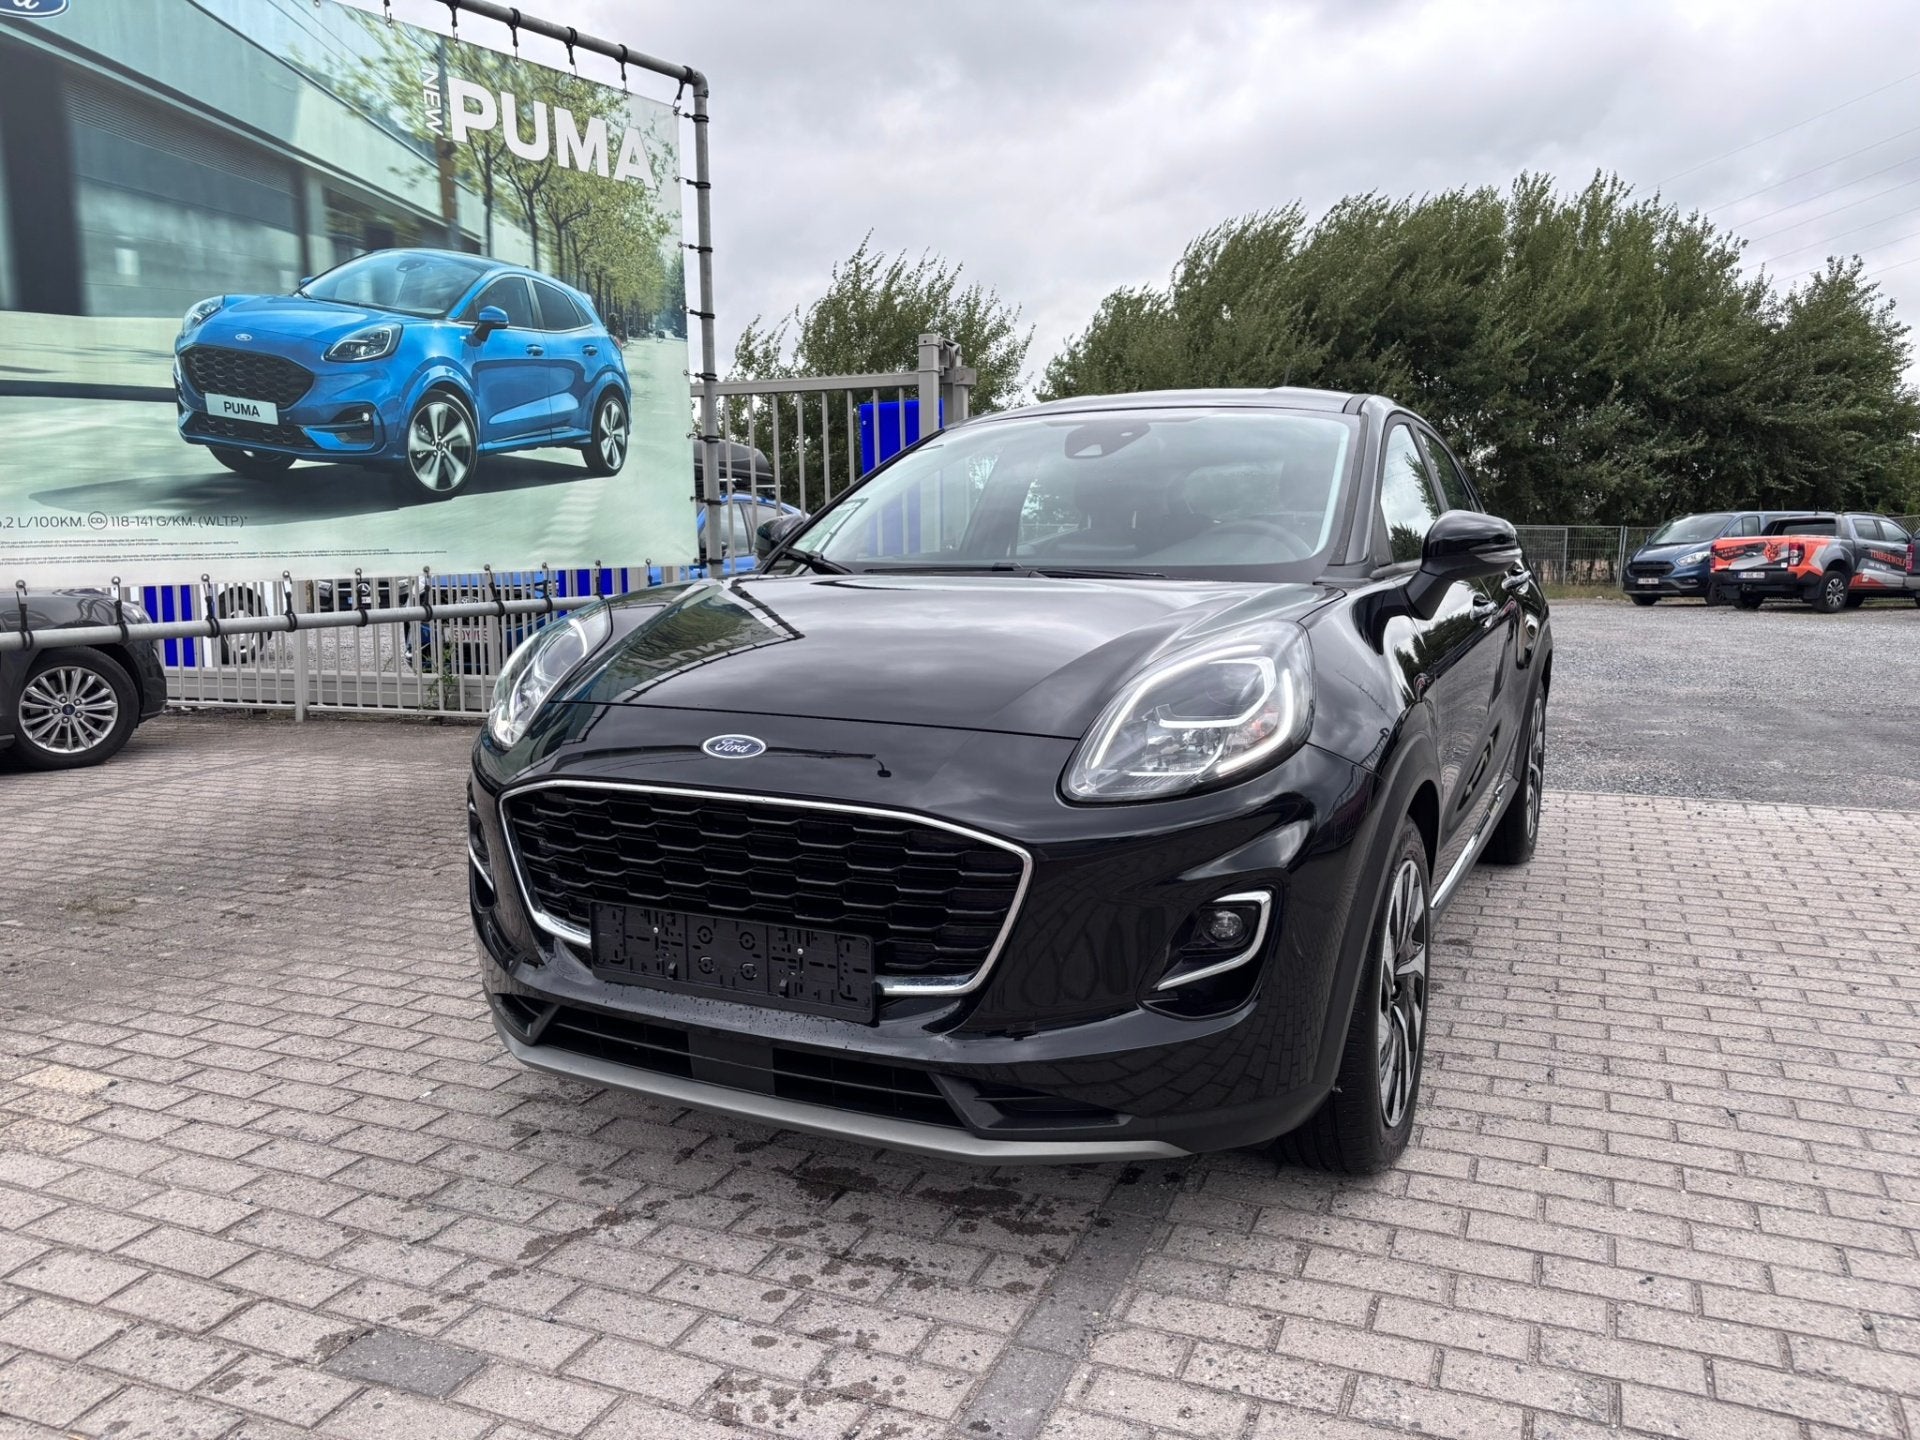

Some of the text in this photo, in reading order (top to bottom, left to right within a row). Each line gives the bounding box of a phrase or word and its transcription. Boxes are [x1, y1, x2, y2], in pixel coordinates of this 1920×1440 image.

[422, 68, 444, 136] NEW
[448, 76, 657, 190] PUMA
[223, 401, 261, 417] PUMA
[0, 517, 14, 529] ,2
[18, 516, 86, 528] L/100KM.
[111, 516, 153, 528] 118-141
[156, 515, 196, 527] G/KM.
[714, 738, 752, 753] Ford
